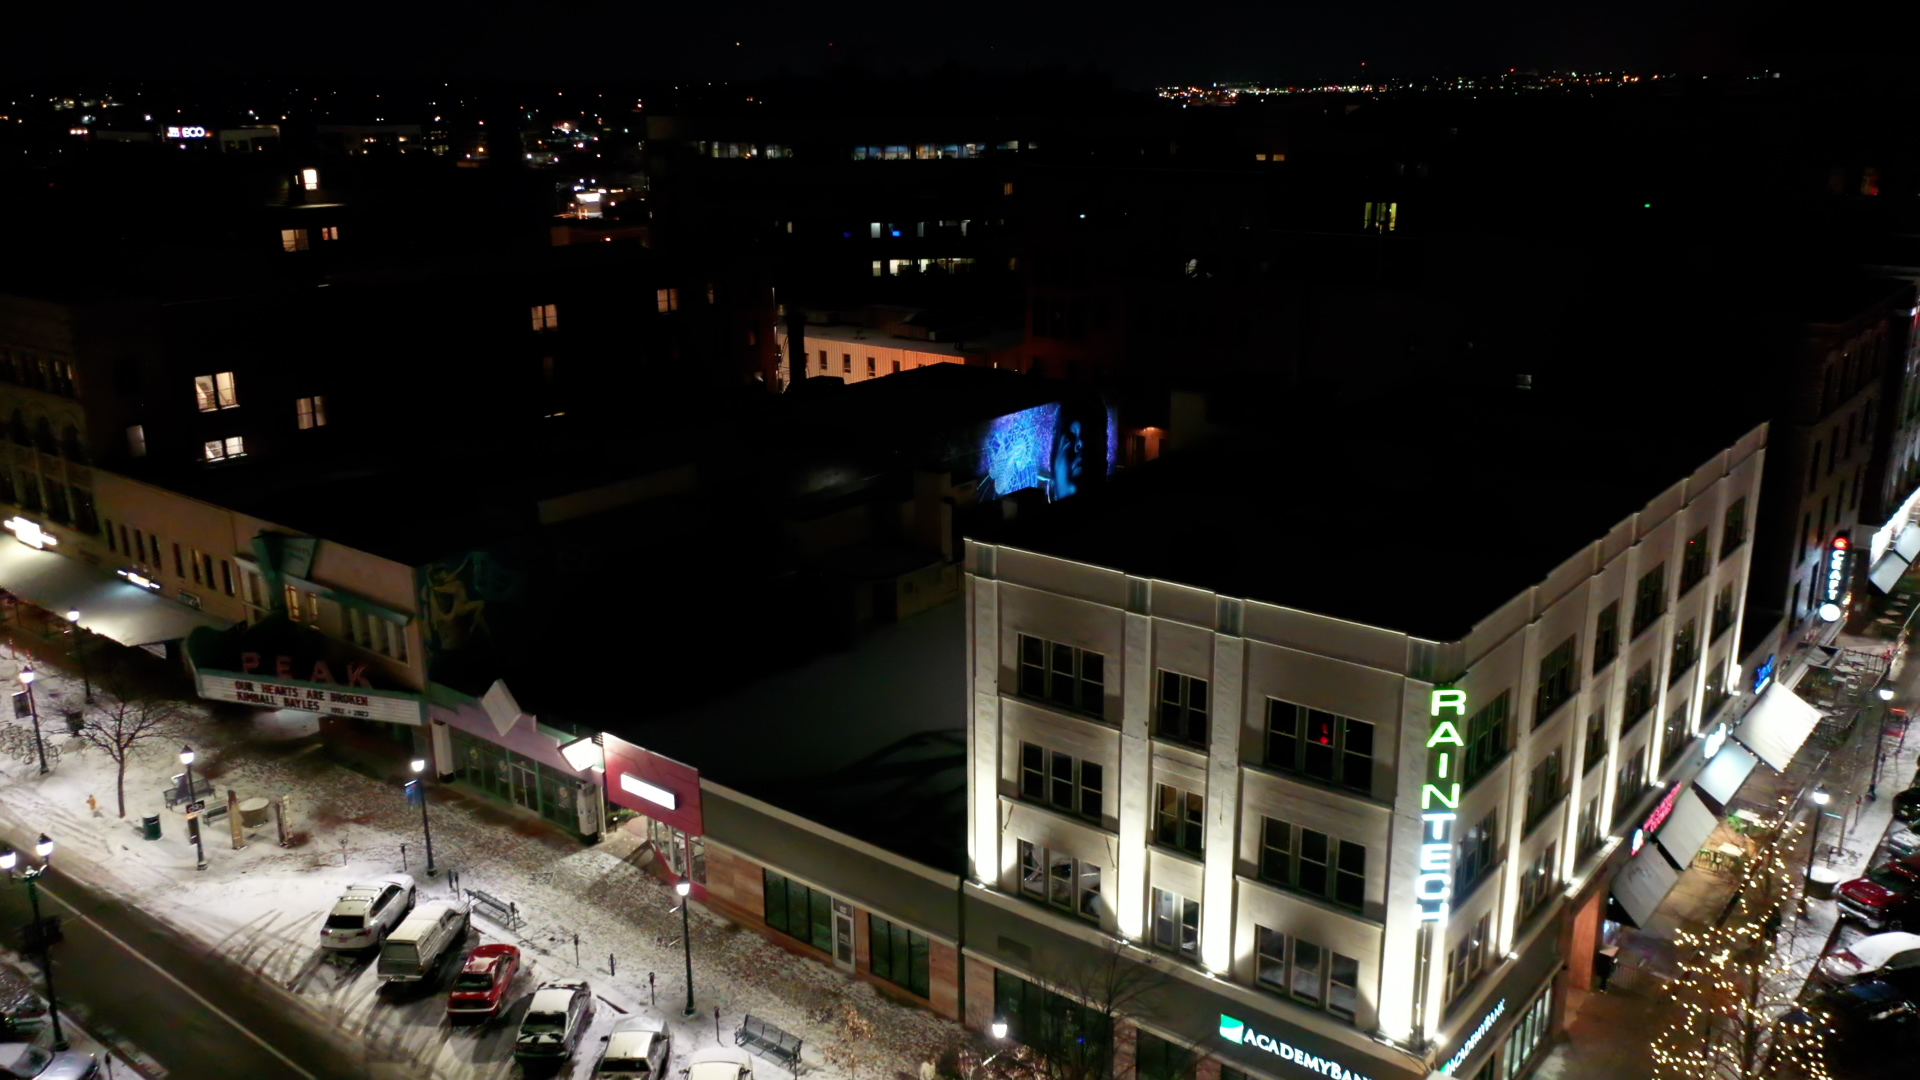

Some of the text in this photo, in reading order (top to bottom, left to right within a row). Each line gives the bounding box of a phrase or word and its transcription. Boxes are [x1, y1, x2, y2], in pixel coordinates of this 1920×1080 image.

[182, 126, 206, 138] ECO
[240, 651, 375, 689] PEAK
[235, 681, 369, 707] OUR HEARTS ARE BROKEN
[237, 691, 277, 706] KIMBALL
[283, 696, 320, 711] BAYLES
[1413, 689, 1467, 929] RAINTECH
[1244, 1028, 1373, 1080] ACADEMYBAN
